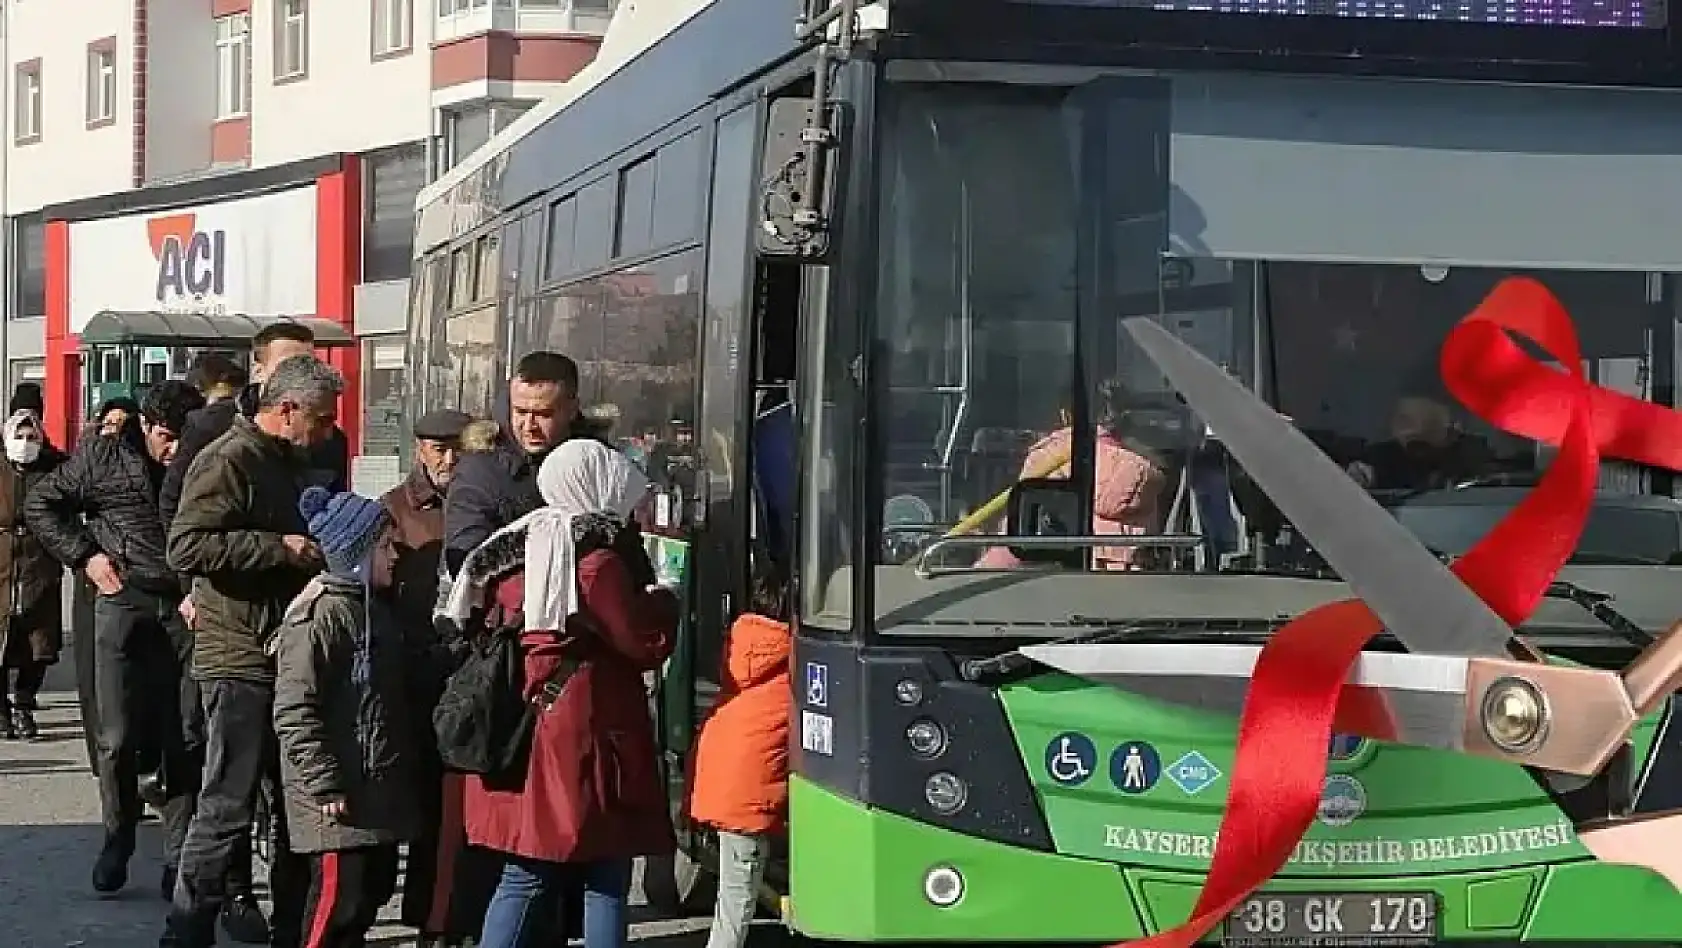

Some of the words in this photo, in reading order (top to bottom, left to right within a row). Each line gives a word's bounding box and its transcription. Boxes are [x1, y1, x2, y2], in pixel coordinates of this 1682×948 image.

[1287, 835, 1405, 869] KŞEHİR
[1409, 817, 1571, 861] BELEDİYESİ
[1244, 900, 1286, 932] 38
[1304, 898, 1343, 932] GK
[1370, 897, 1426, 932] 170
